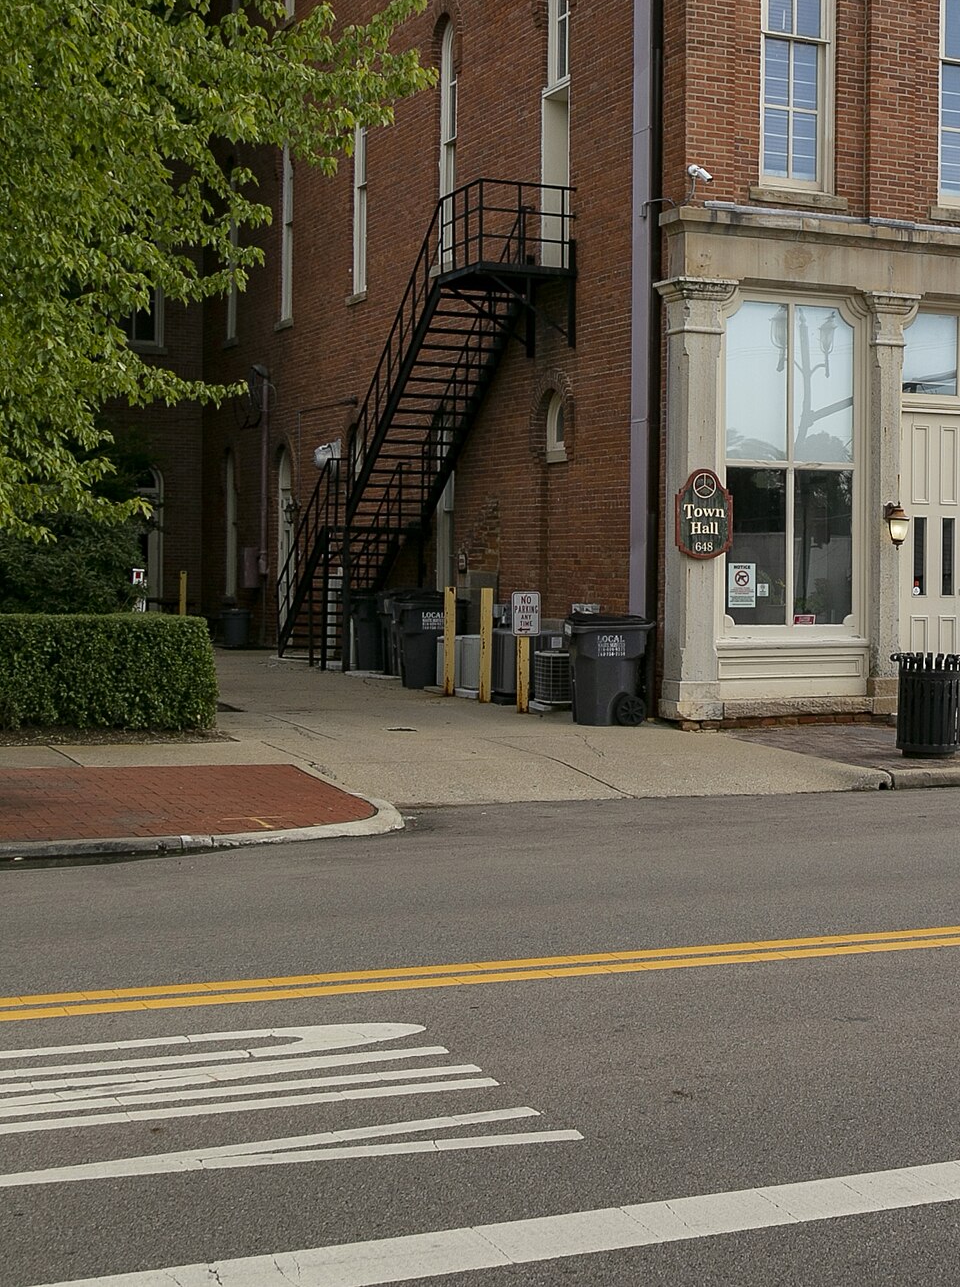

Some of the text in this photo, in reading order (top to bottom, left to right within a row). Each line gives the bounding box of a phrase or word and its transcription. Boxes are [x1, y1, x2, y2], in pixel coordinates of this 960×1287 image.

[683, 503, 726, 520] Town
[690, 521, 719, 535] Hall
[695, 541, 713, 552] 648
[520, 595, 532, 604] NO
[514, 605, 538, 614] PARKING
[597, 634, 625, 643] LOCAL
